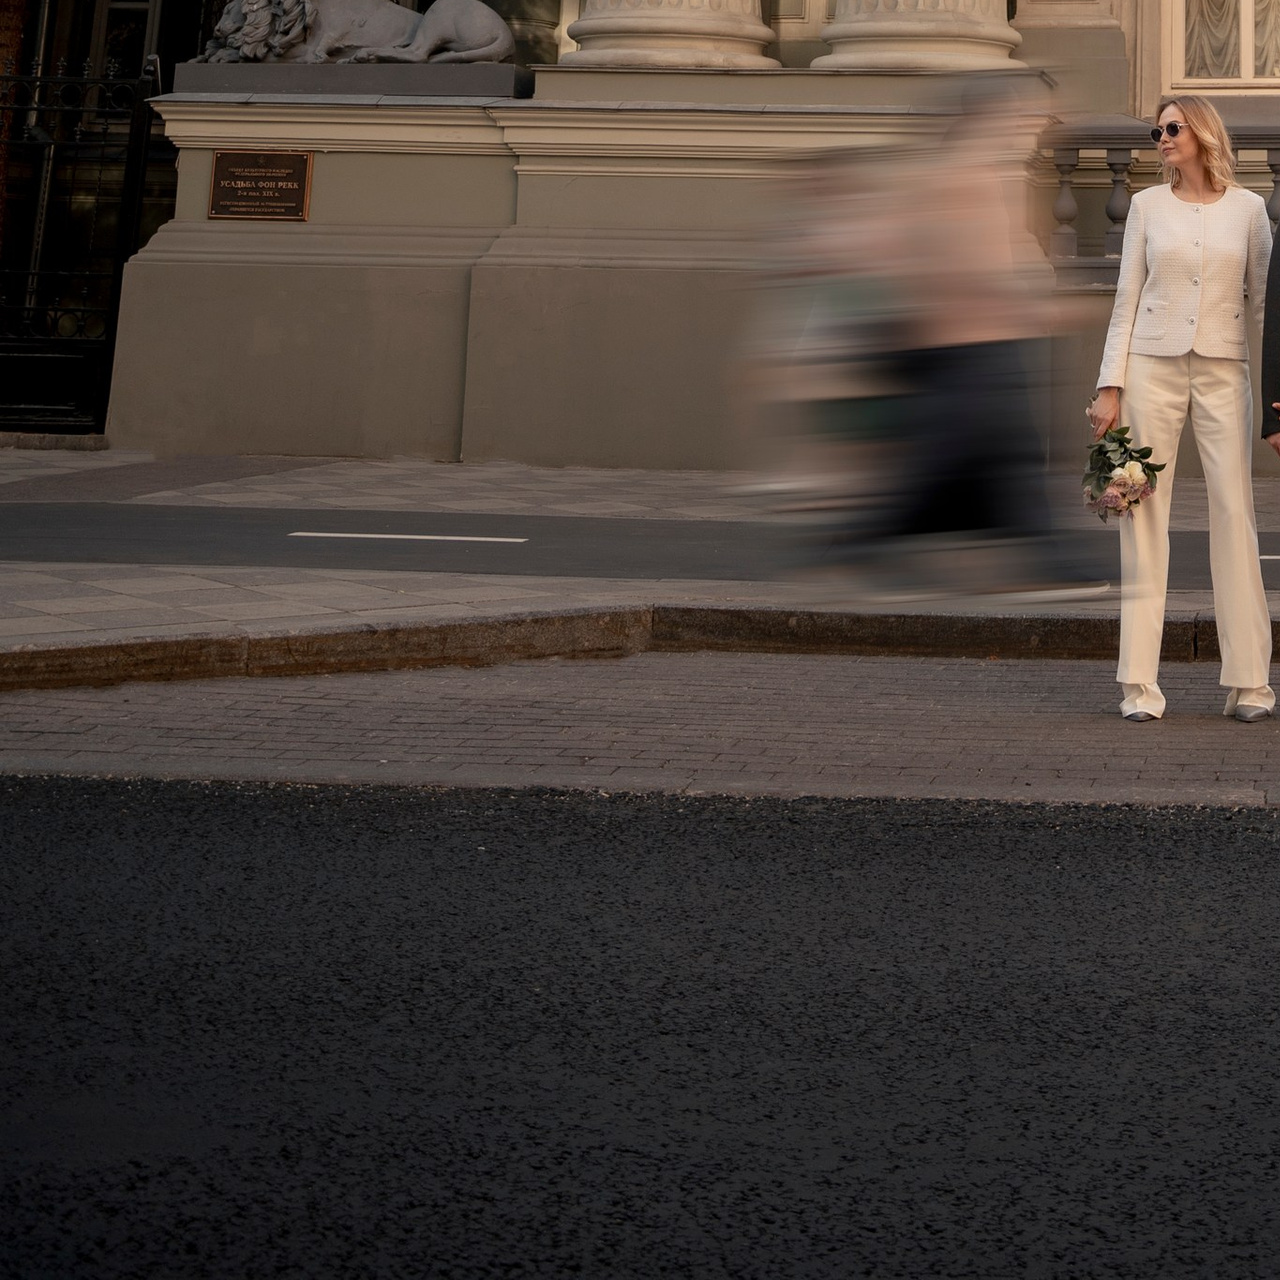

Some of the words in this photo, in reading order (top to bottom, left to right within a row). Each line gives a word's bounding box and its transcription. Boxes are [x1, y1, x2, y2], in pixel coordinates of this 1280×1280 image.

[220, 180, 256, 188] УСАДЬБА
[257, 181, 276, 189] ФОН
[278, 181, 299, 189] РЕКК
